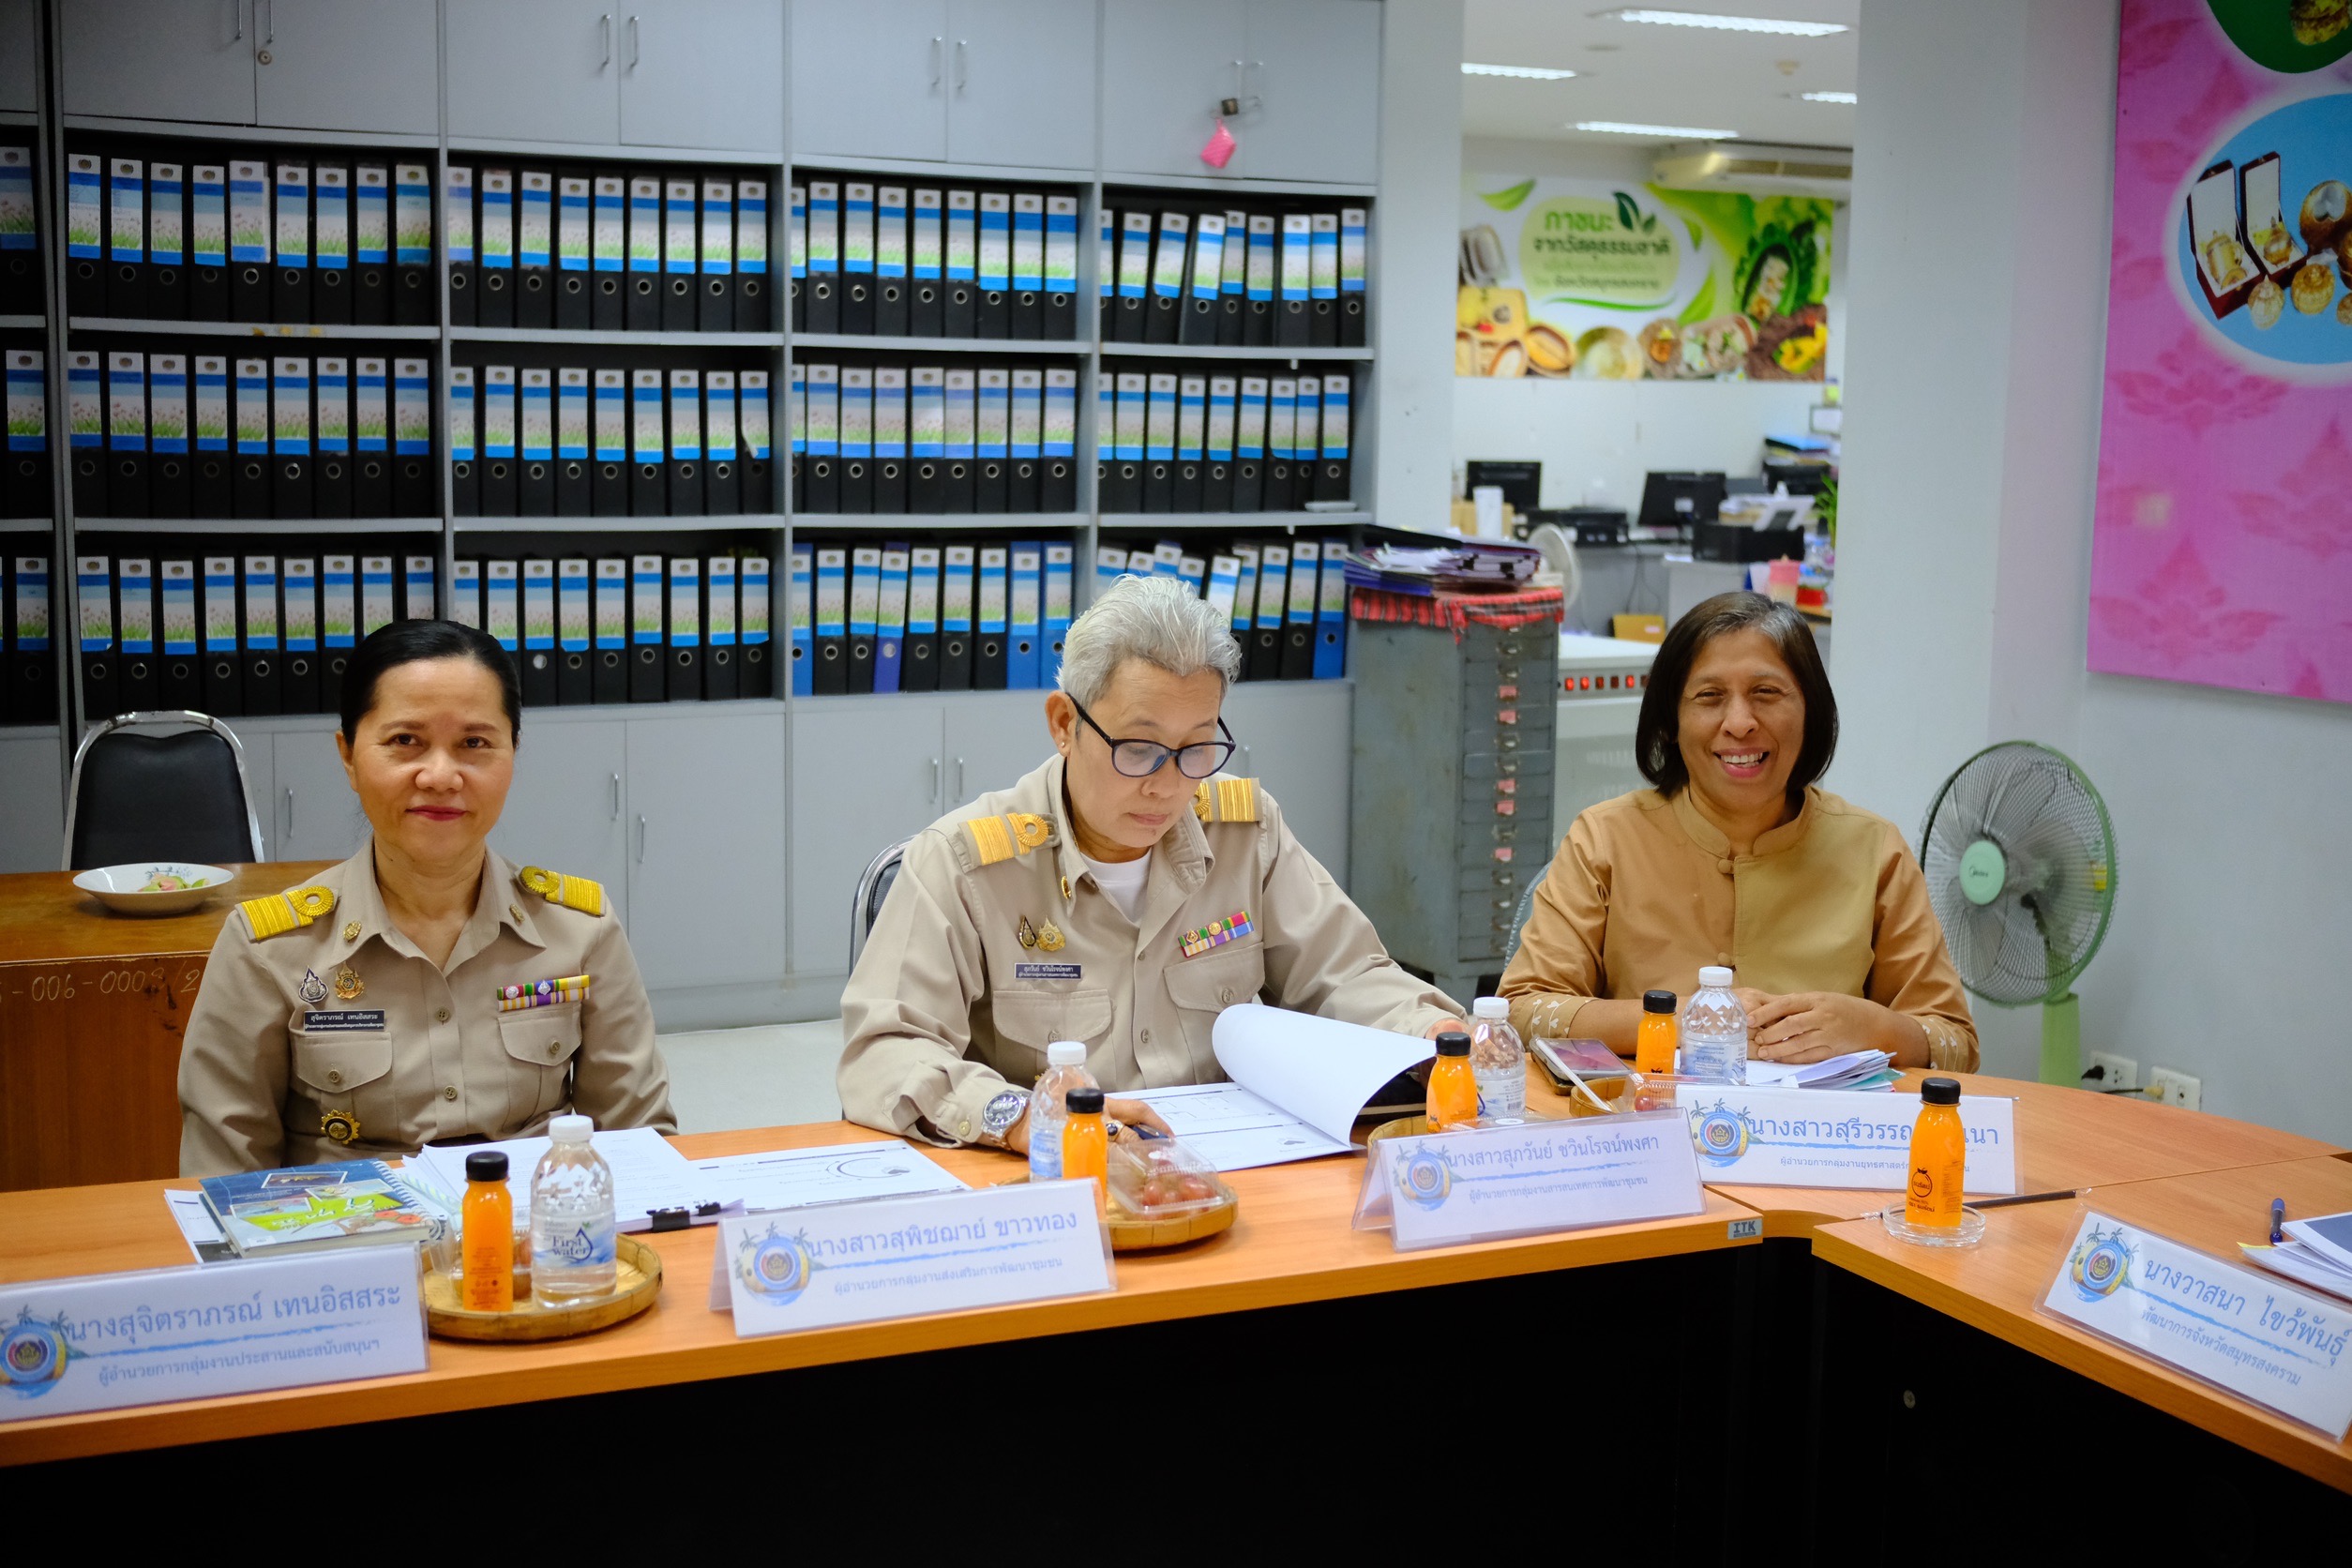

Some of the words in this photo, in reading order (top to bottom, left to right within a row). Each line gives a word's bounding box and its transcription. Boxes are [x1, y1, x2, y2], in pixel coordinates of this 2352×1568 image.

[1448, 1138, 1553, 1168] นางสาวสุภวันย์
[1559, 1133, 1659, 1158] ชวินโรจน์พงศา
[552, 1236, 582, 1247] First
[994, 1212, 1078, 1236] ขาวทอง
[1733, 1221, 1756, 1233] ITK
[2144, 1259, 2246, 1316] นางวาสนา
[68, 1291, 263, 1345] นางสุจิตราภรณ์
[274, 1286, 401, 1319] เทนอิสสระ
[2141, 1305, 2302, 1387] พัฒนาการจังหวัดสมุทรสงคราม
